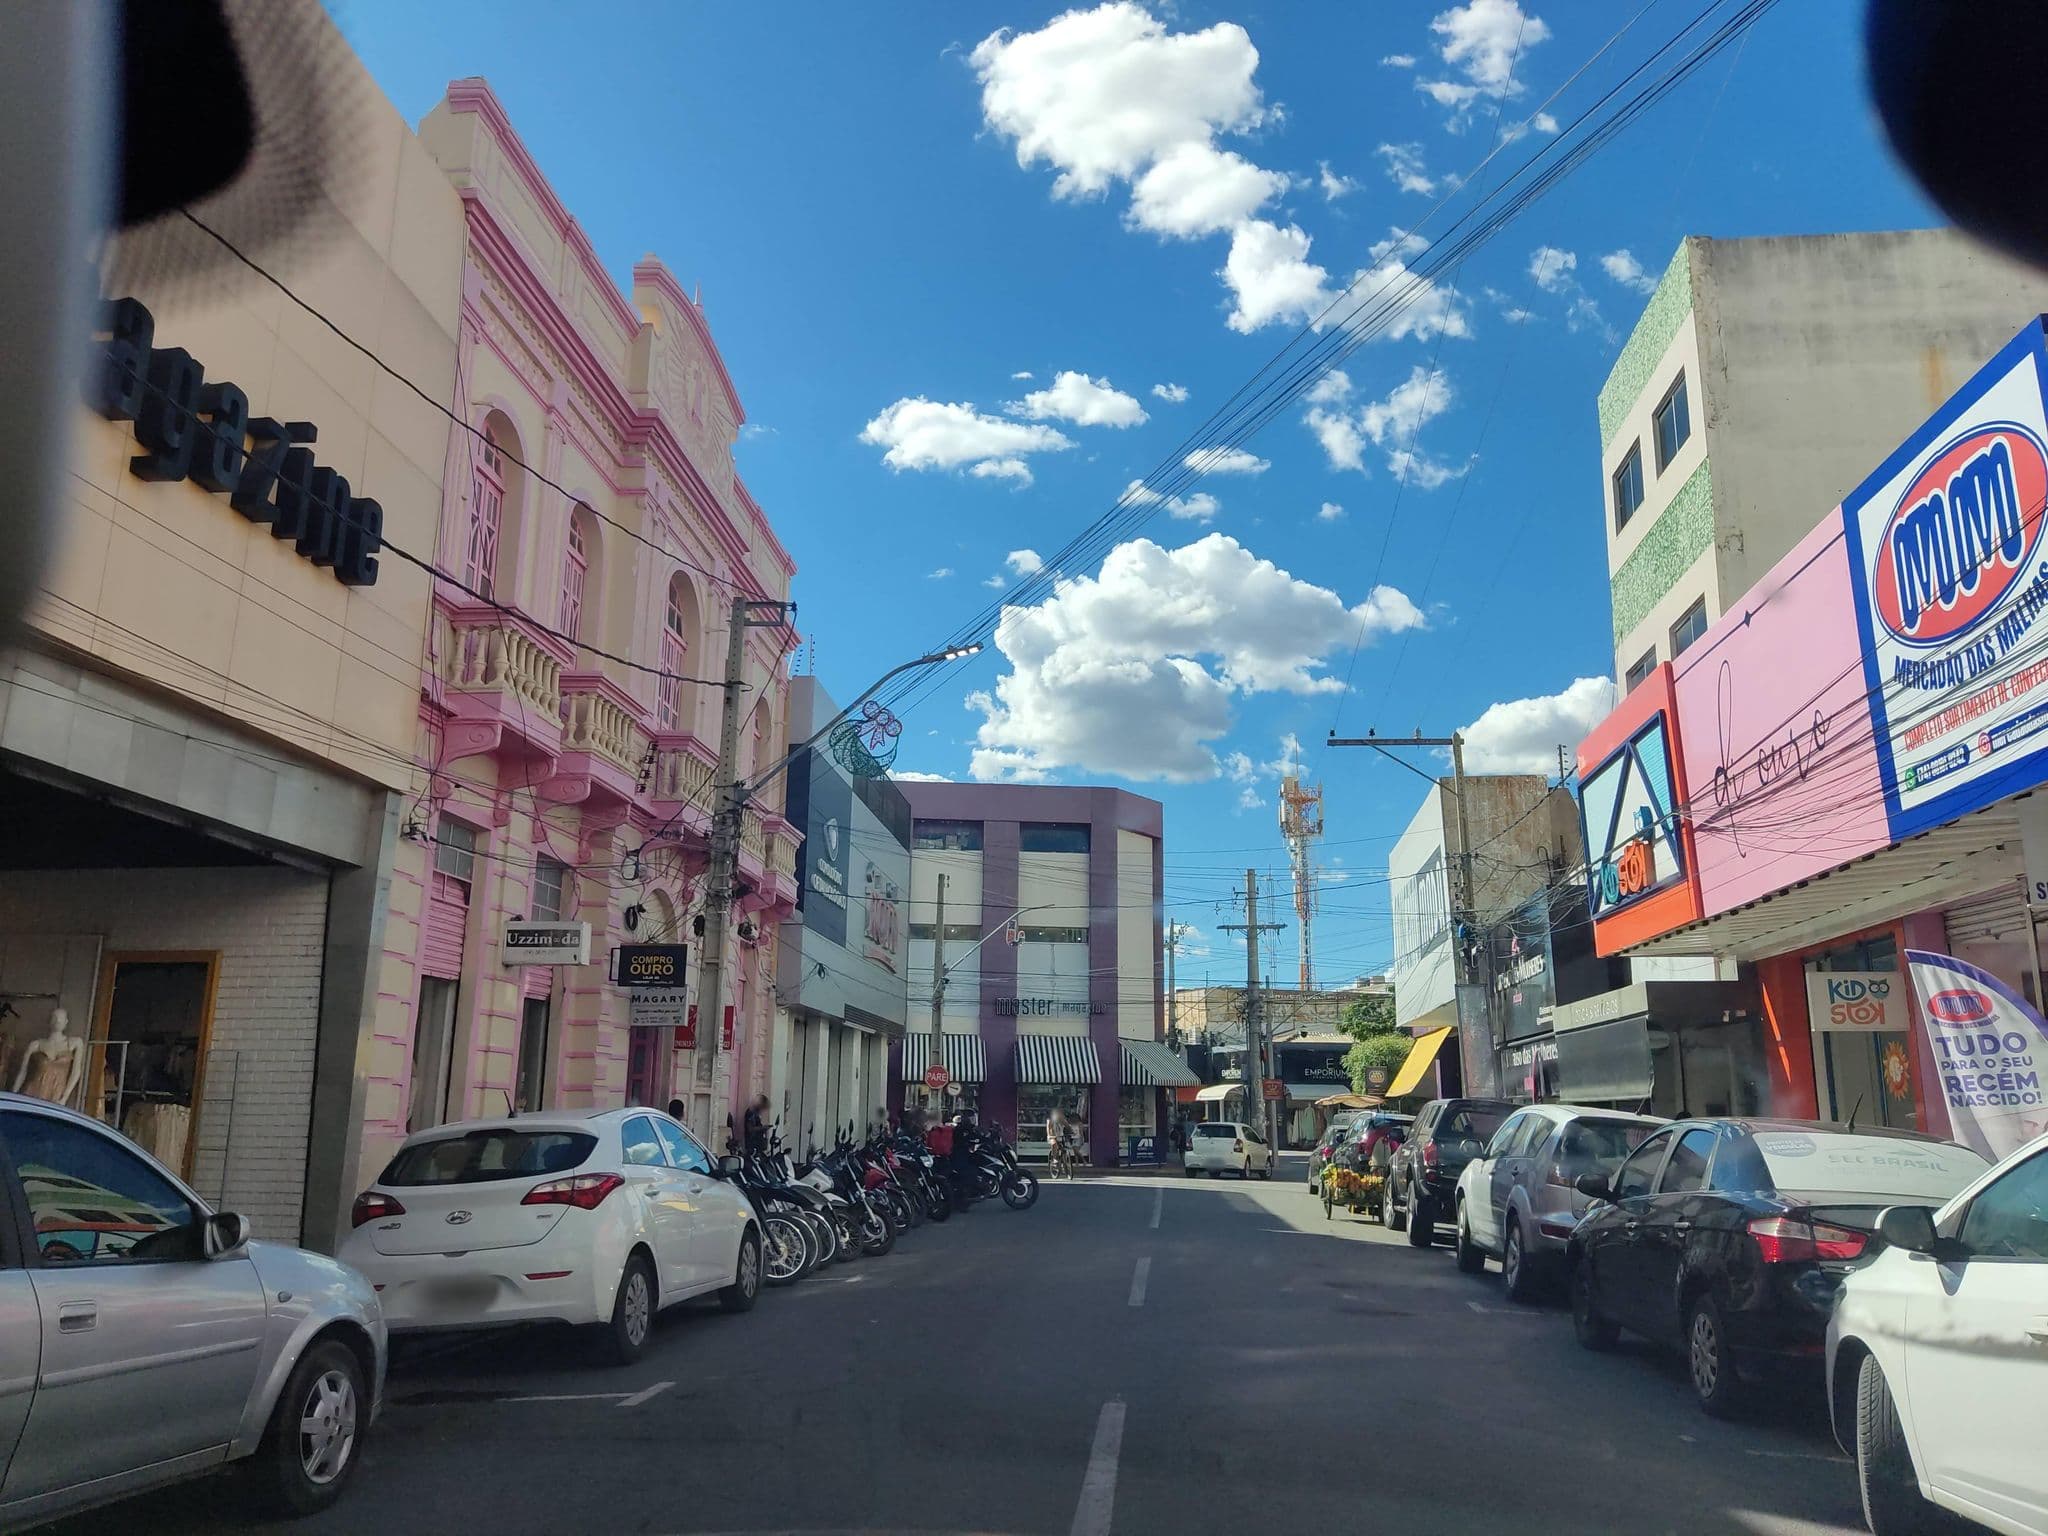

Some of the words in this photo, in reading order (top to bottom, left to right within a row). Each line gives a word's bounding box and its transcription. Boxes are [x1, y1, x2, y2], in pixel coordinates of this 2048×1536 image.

[1894, 651, 1965, 690] MERCADÃO
[1967, 635, 1996, 679] DAS
[1904, 714, 1944, 751] COMPLETO
[631, 955, 674, 964] COMPRO
[630, 964, 674, 976] OURO
[631, 995, 685, 1004] MAGARY
[996, 997, 1054, 1016] master
[1935, 1031, 2028, 1057] TUDO
[1942, 1059, 1979, 1071] PARA
[1984, 1058, 1997, 1069] O
[2001, 1056, 2033, 1069] SEU
[928, 1072, 947, 1082] PARE
[1945, 1067, 2039, 1093] RECÉM
[1950, 1091, 2043, 1108] NASCIDO!
[1872, 1156, 1949, 1172] BRASIL
